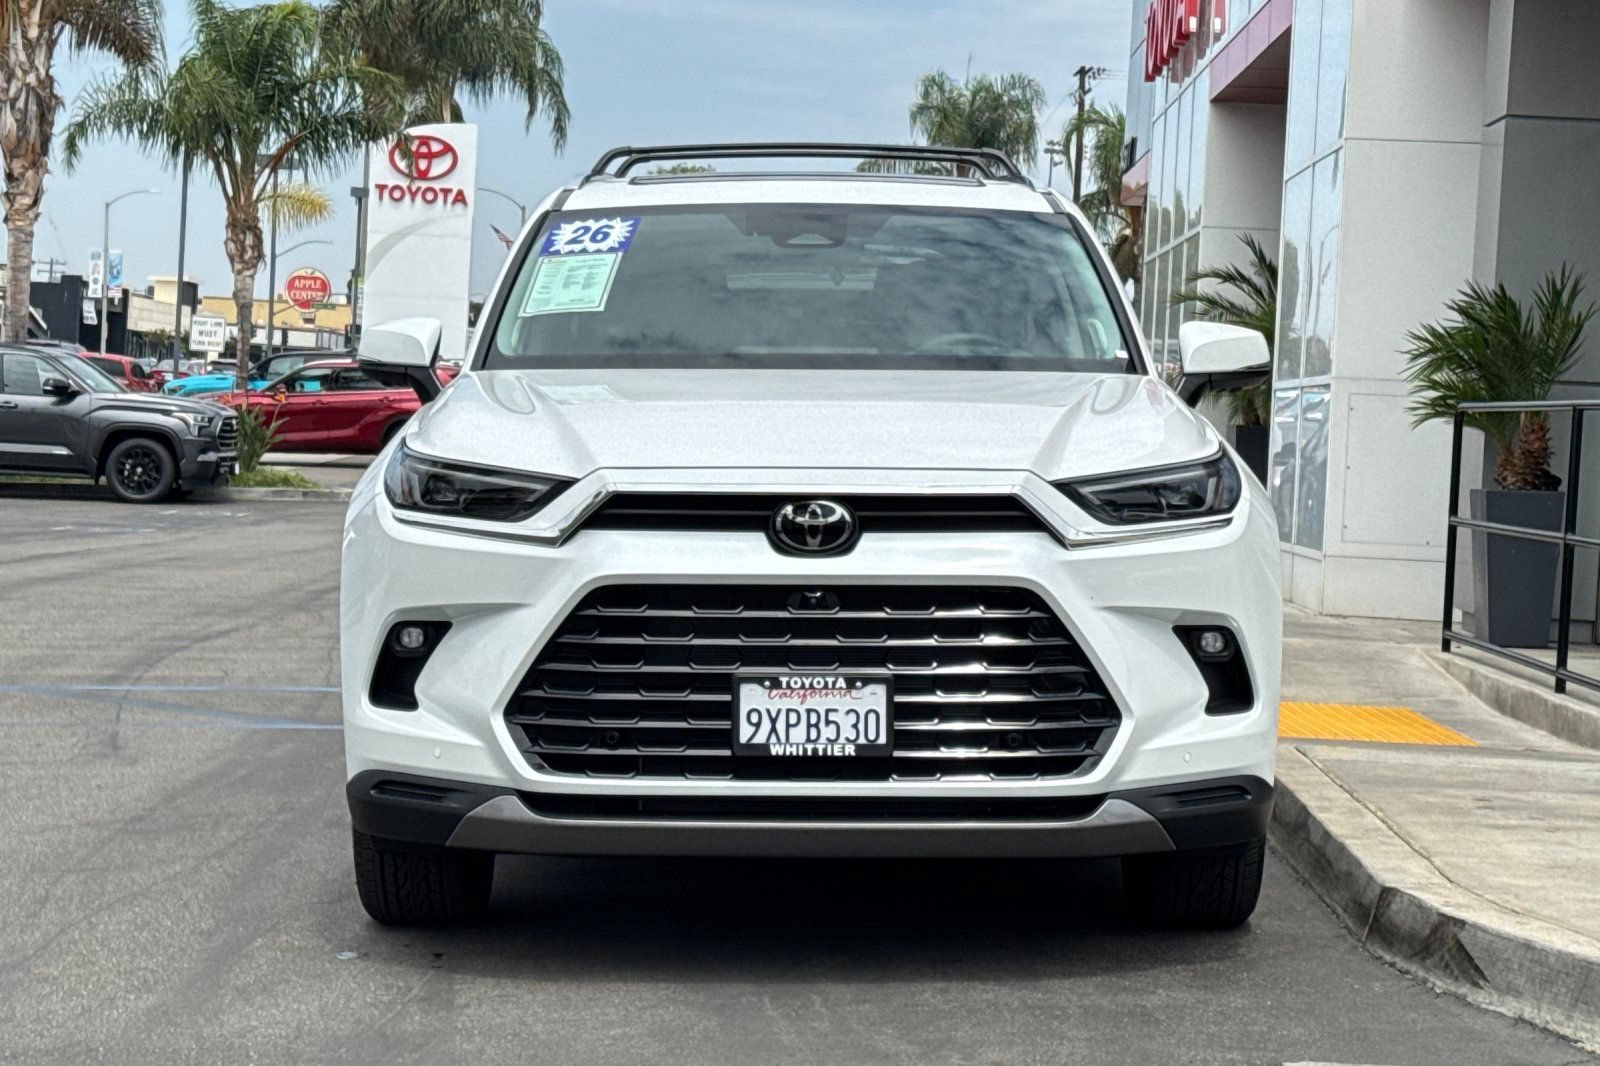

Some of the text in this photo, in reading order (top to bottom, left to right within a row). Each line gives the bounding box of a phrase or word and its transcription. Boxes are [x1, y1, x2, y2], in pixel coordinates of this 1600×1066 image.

[374, 183, 468, 207] TOYOTA
[563, 224, 616, 246] 26
[294, 278, 322, 289] APPLE
[779, 676, 847, 689] TOYOTA
[768, 689, 863, 705] California
[746, 708, 881, 743] 9XPB530
[769, 743, 856, 756] WHITTIER
